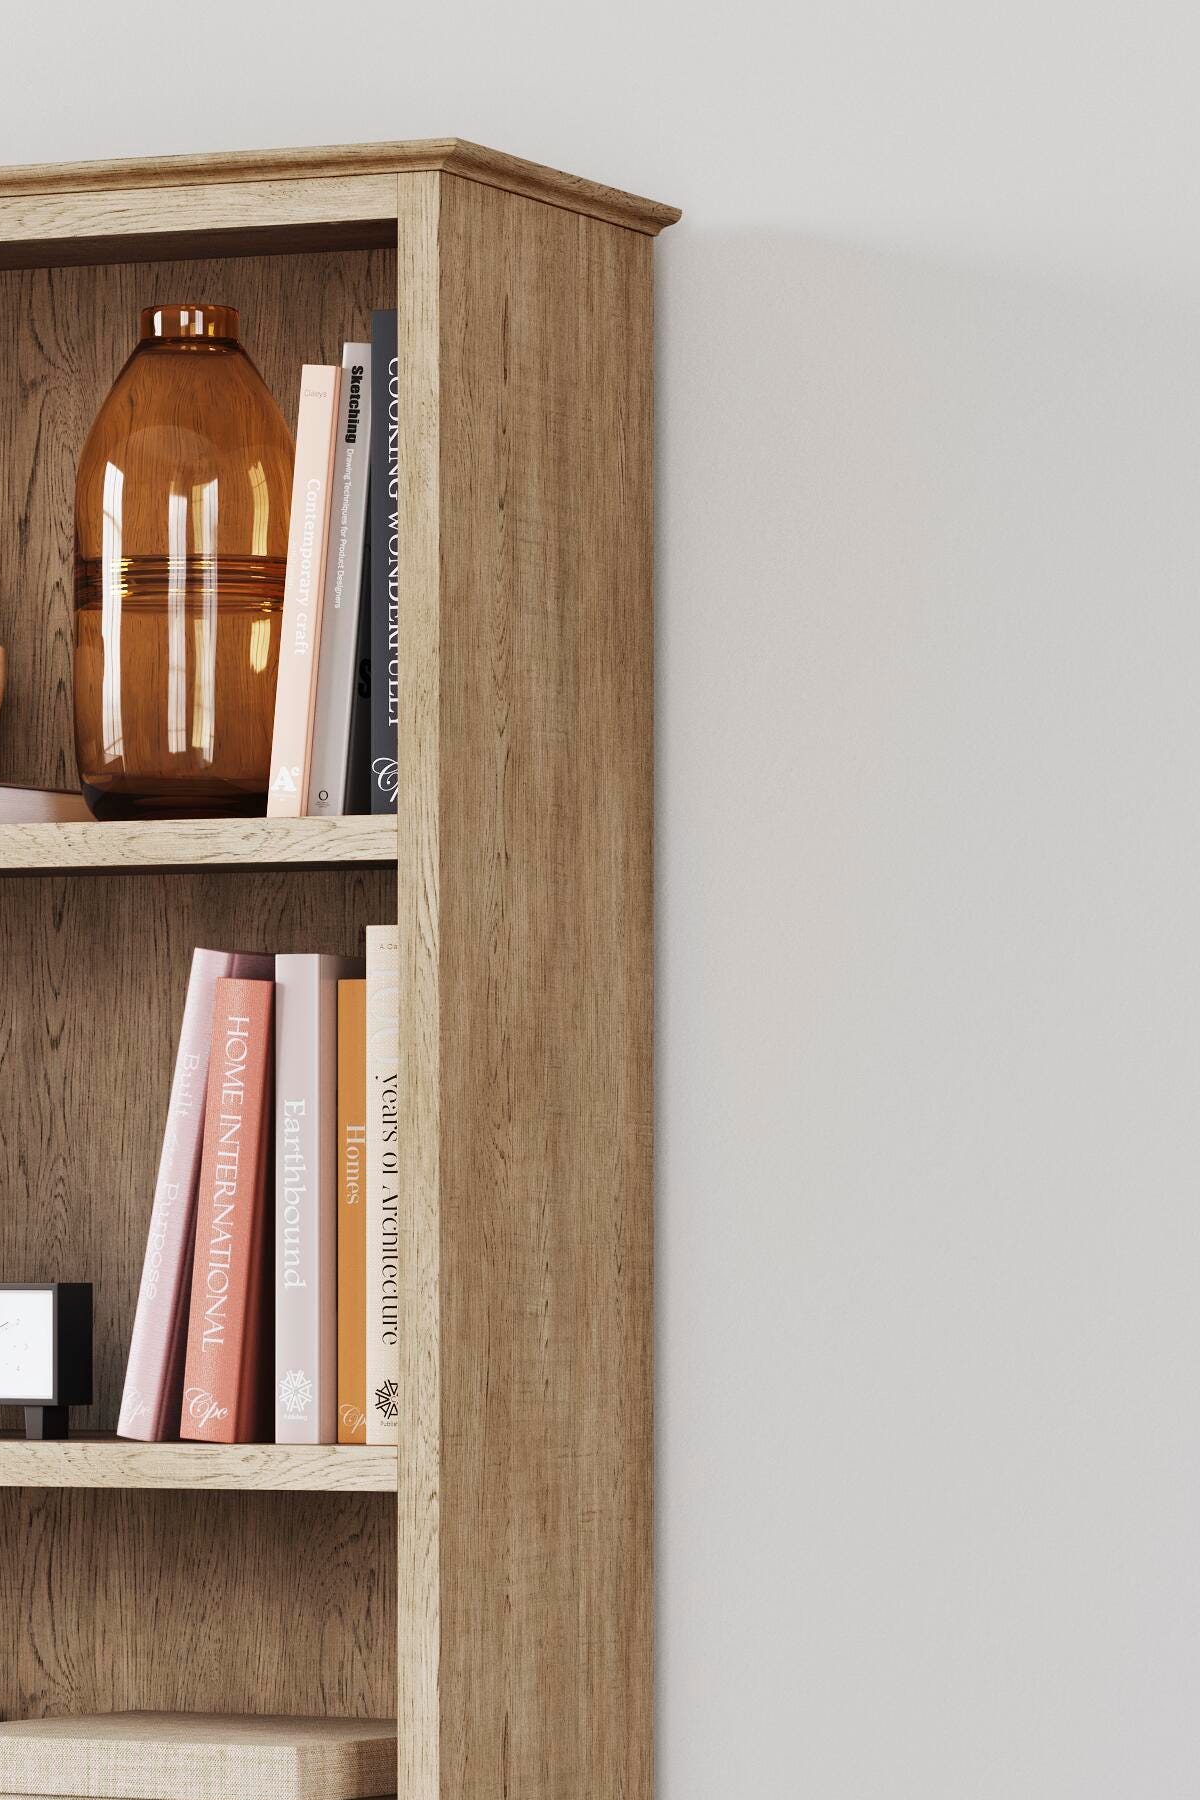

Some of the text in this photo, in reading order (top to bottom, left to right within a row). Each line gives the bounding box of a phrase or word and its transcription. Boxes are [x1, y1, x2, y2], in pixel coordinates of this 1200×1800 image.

[294, 478, 321, 656] Contemporary craft
[334, 364, 364, 609] Sketching Drawing Techniques for Product Designers
[175, 1054, 200, 1117] Built
[345, 1123, 366, 1206] Homes
[375, 1073, 398, 1142] years
[147, 1182, 179, 1298] Purpose
[202, 1016, 250, 1353] HOME INTERNATIONAL
[284, 1098, 307, 1289] Earthbound
[382, 1185, 398, 1346] Architecture
